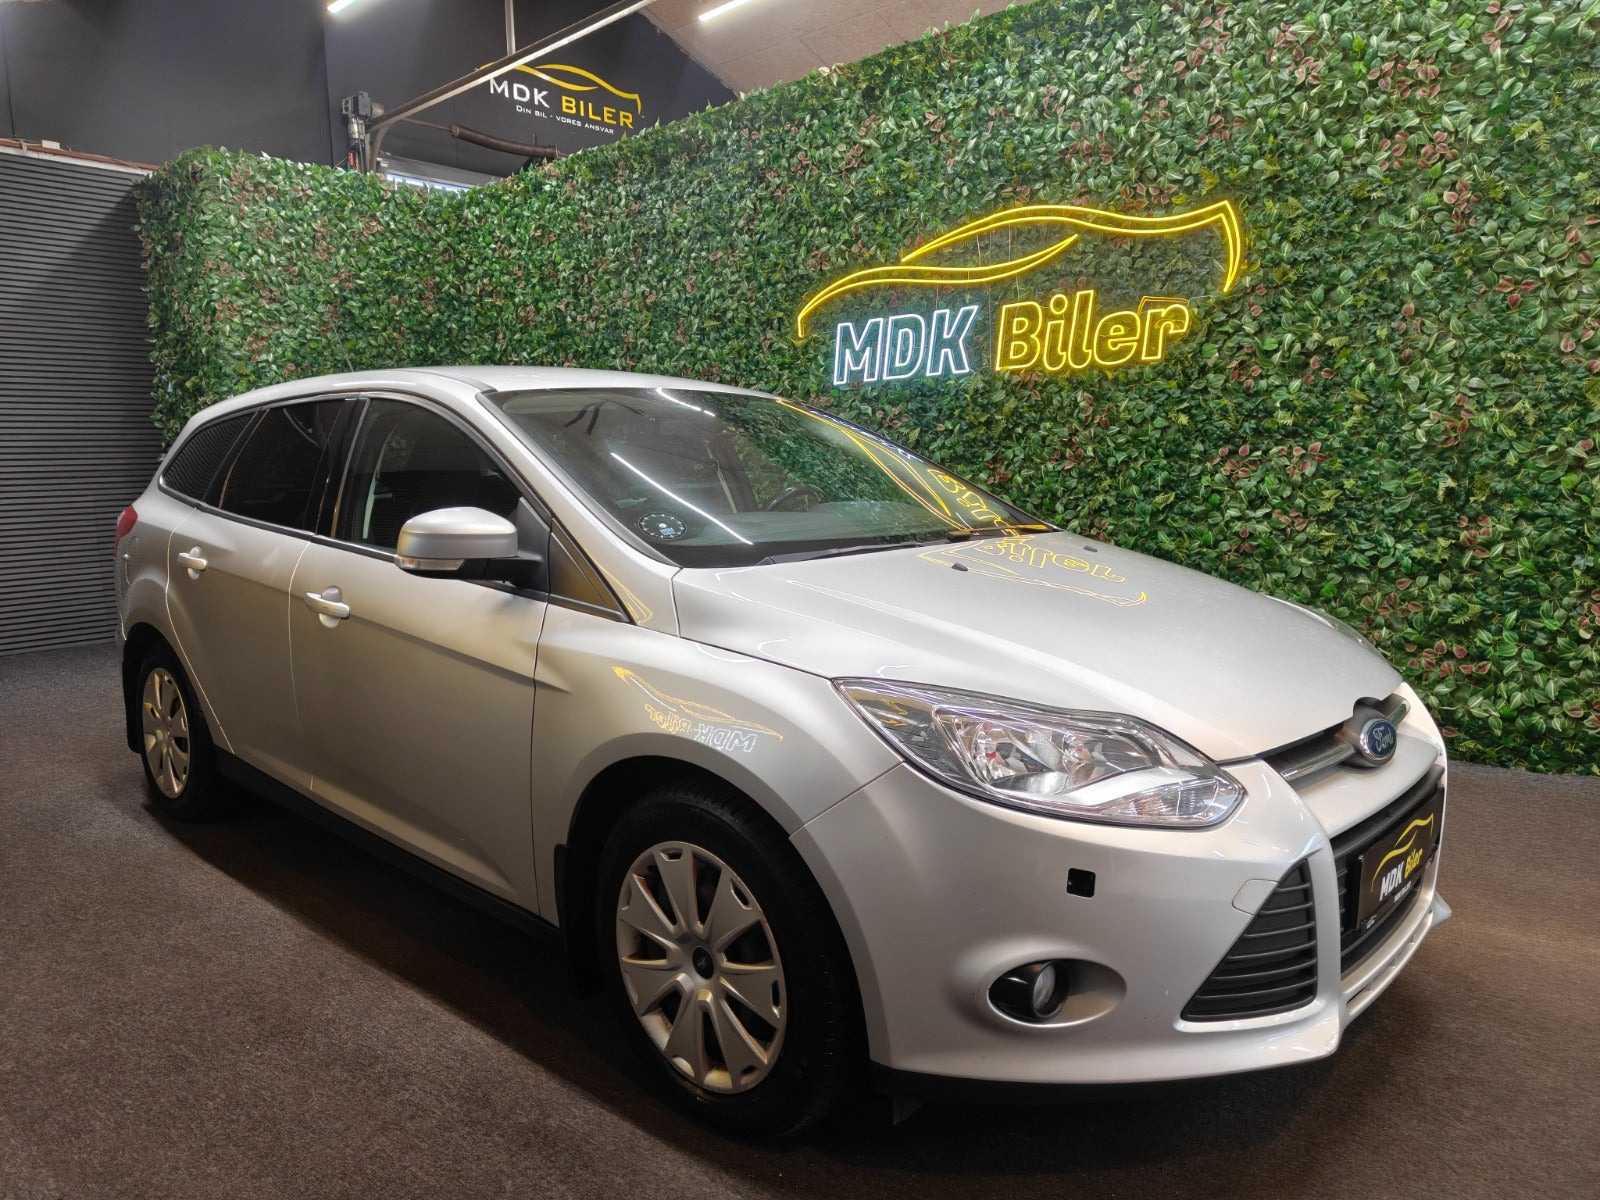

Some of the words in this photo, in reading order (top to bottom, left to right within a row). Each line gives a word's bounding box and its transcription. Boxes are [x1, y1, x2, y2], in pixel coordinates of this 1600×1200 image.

[489, 77, 550, 109] MDK
[561, 95, 633, 129] BILER
[833, 305, 979, 386] MDK
[996, 290, 1191, 372] Biler
[1372, 725, 1394, 752] Ford
[1379, 860, 1405, 901] MDK
